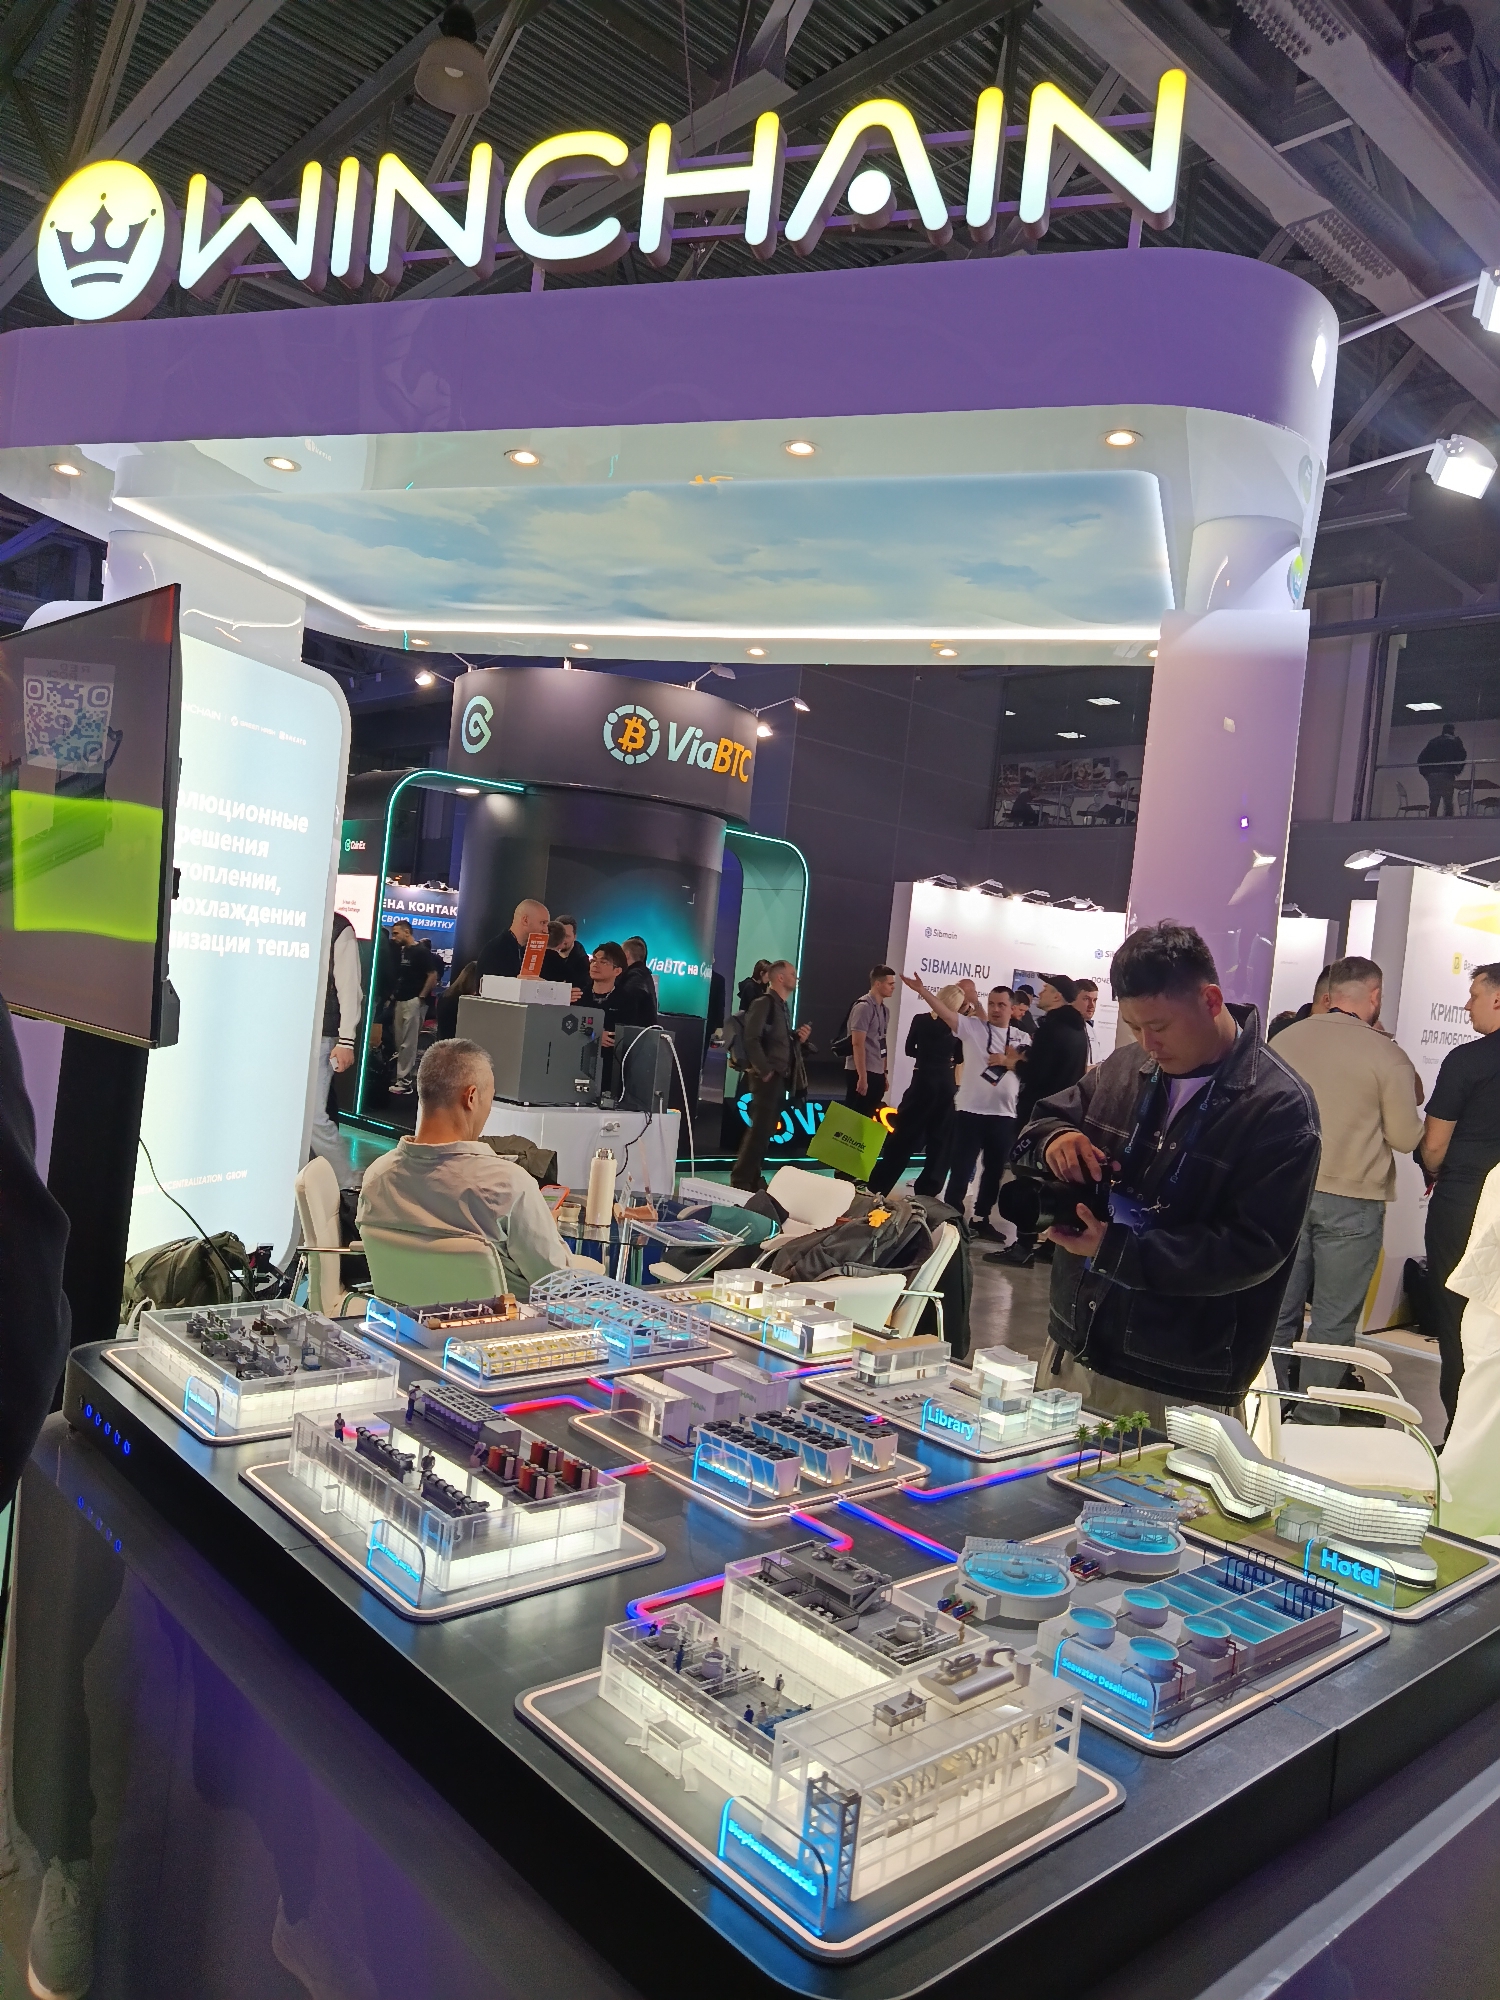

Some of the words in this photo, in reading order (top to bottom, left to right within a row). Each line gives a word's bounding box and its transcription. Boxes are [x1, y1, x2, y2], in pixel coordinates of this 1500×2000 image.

[179, 68, 1188, 291] WINCHAIN
[667, 721, 753, 783] ViaBTC
[933, 928, 958, 940] Sibmain
[256, 937, 310, 959] тепла
[645, 957, 687, 977] ViaBTC
[920, 957, 991, 980] SIBMAIN.RU
[1421, 1029, 1439, 1046] ДЛЯ
[225, 1169, 248, 1181] GROW
[927, 1404, 975, 1441] Library
[1321, 1548, 1380, 1588] Hotel
[1061, 1657, 1098, 1682] Seawater
[1098, 1675, 1149, 1708] Desalination
